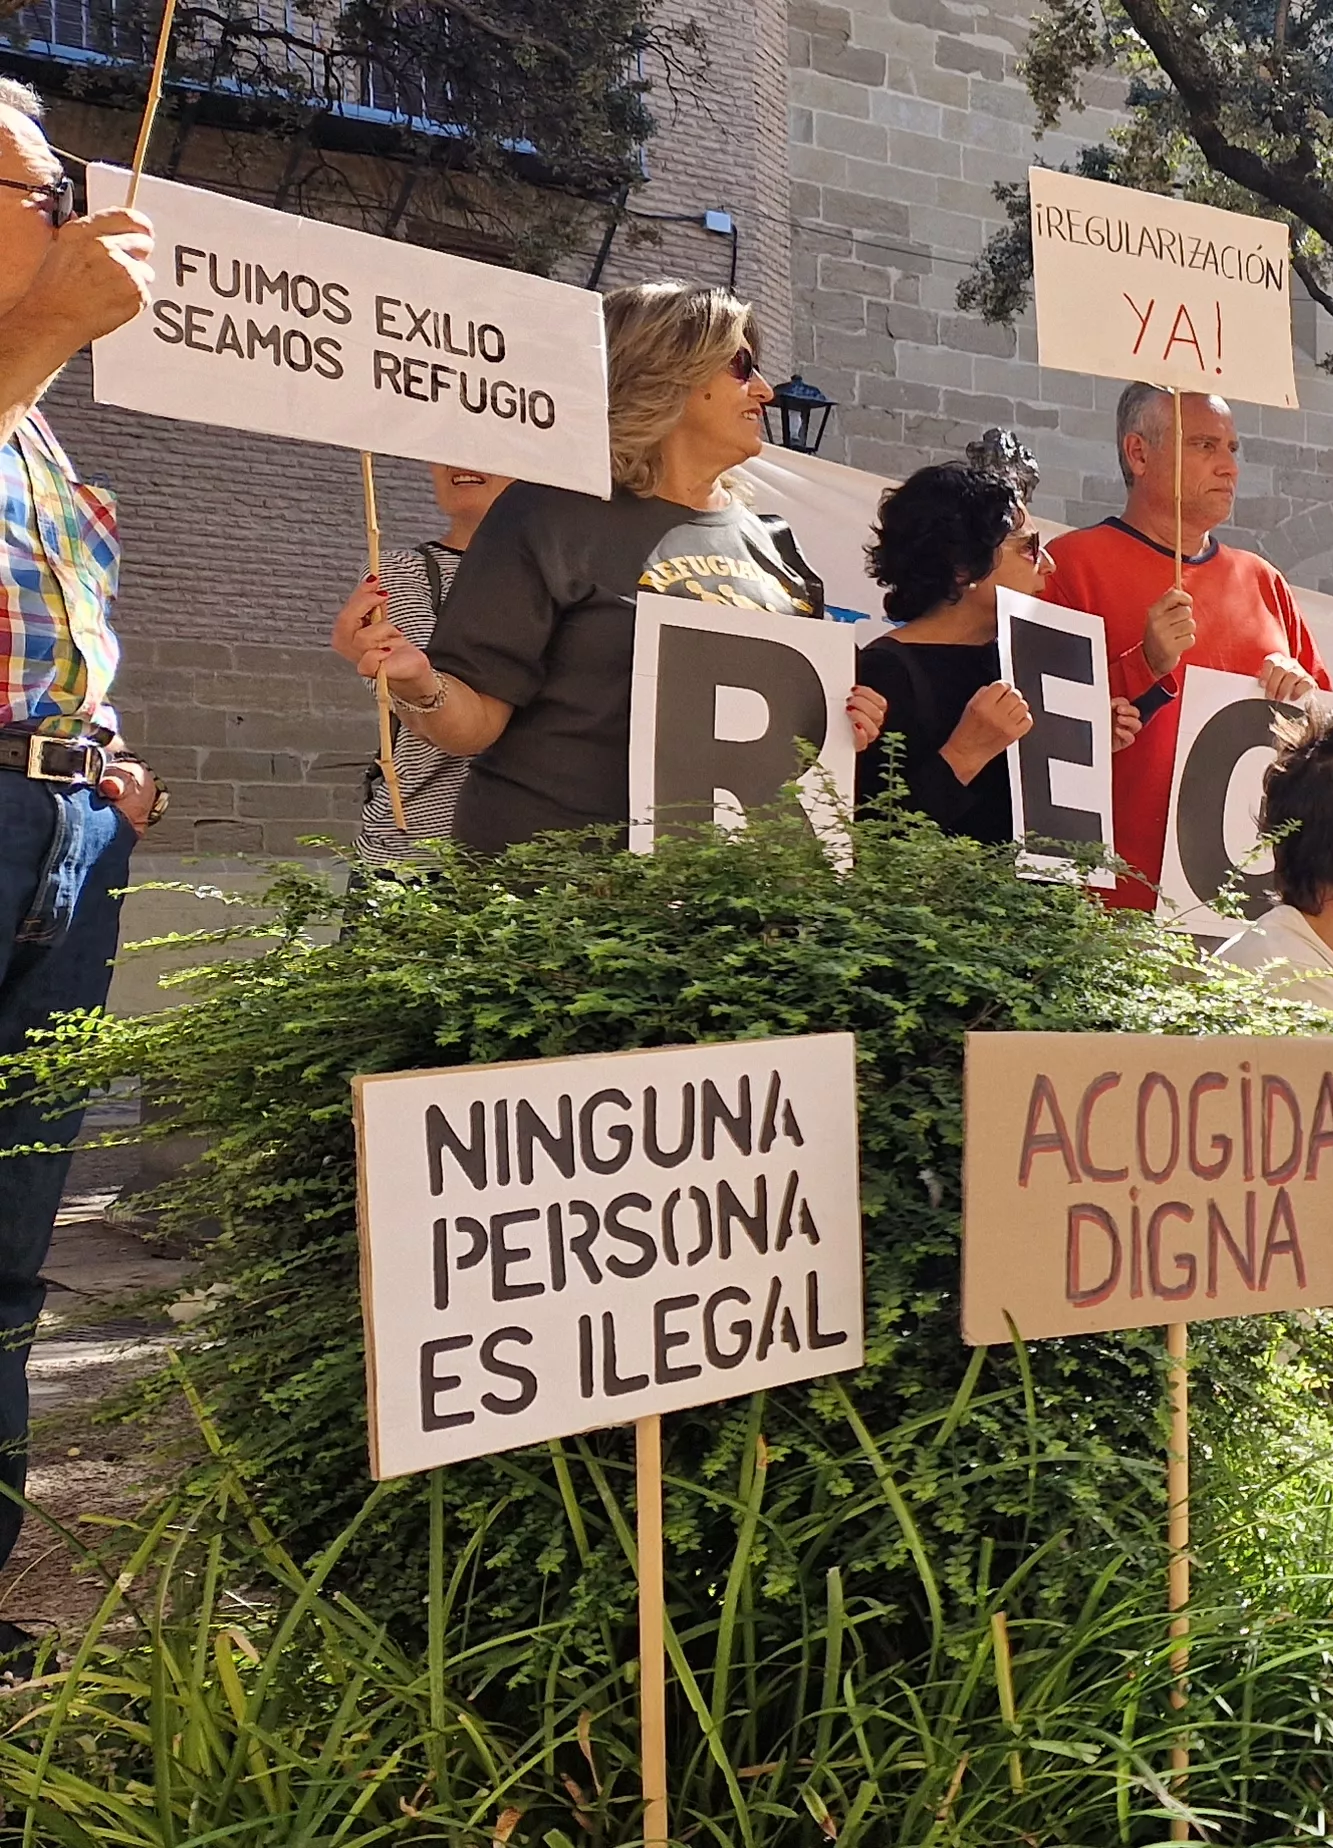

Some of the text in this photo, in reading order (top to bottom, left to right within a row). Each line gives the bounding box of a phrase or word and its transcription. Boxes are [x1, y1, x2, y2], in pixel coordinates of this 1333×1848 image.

[152, 299, 556, 430] SEAMOS REFUGIO
[174, 244, 506, 364] FUIMOS EXILIO
[1123, 292, 1222, 375] YA!
[424, 1068, 805, 1197] NINGUNA
[432, 1170, 822, 1312] PERSONA
[1064, 1185, 1309, 1309] DIGNA
[420, 1270, 849, 1434] ES ILEGAL
